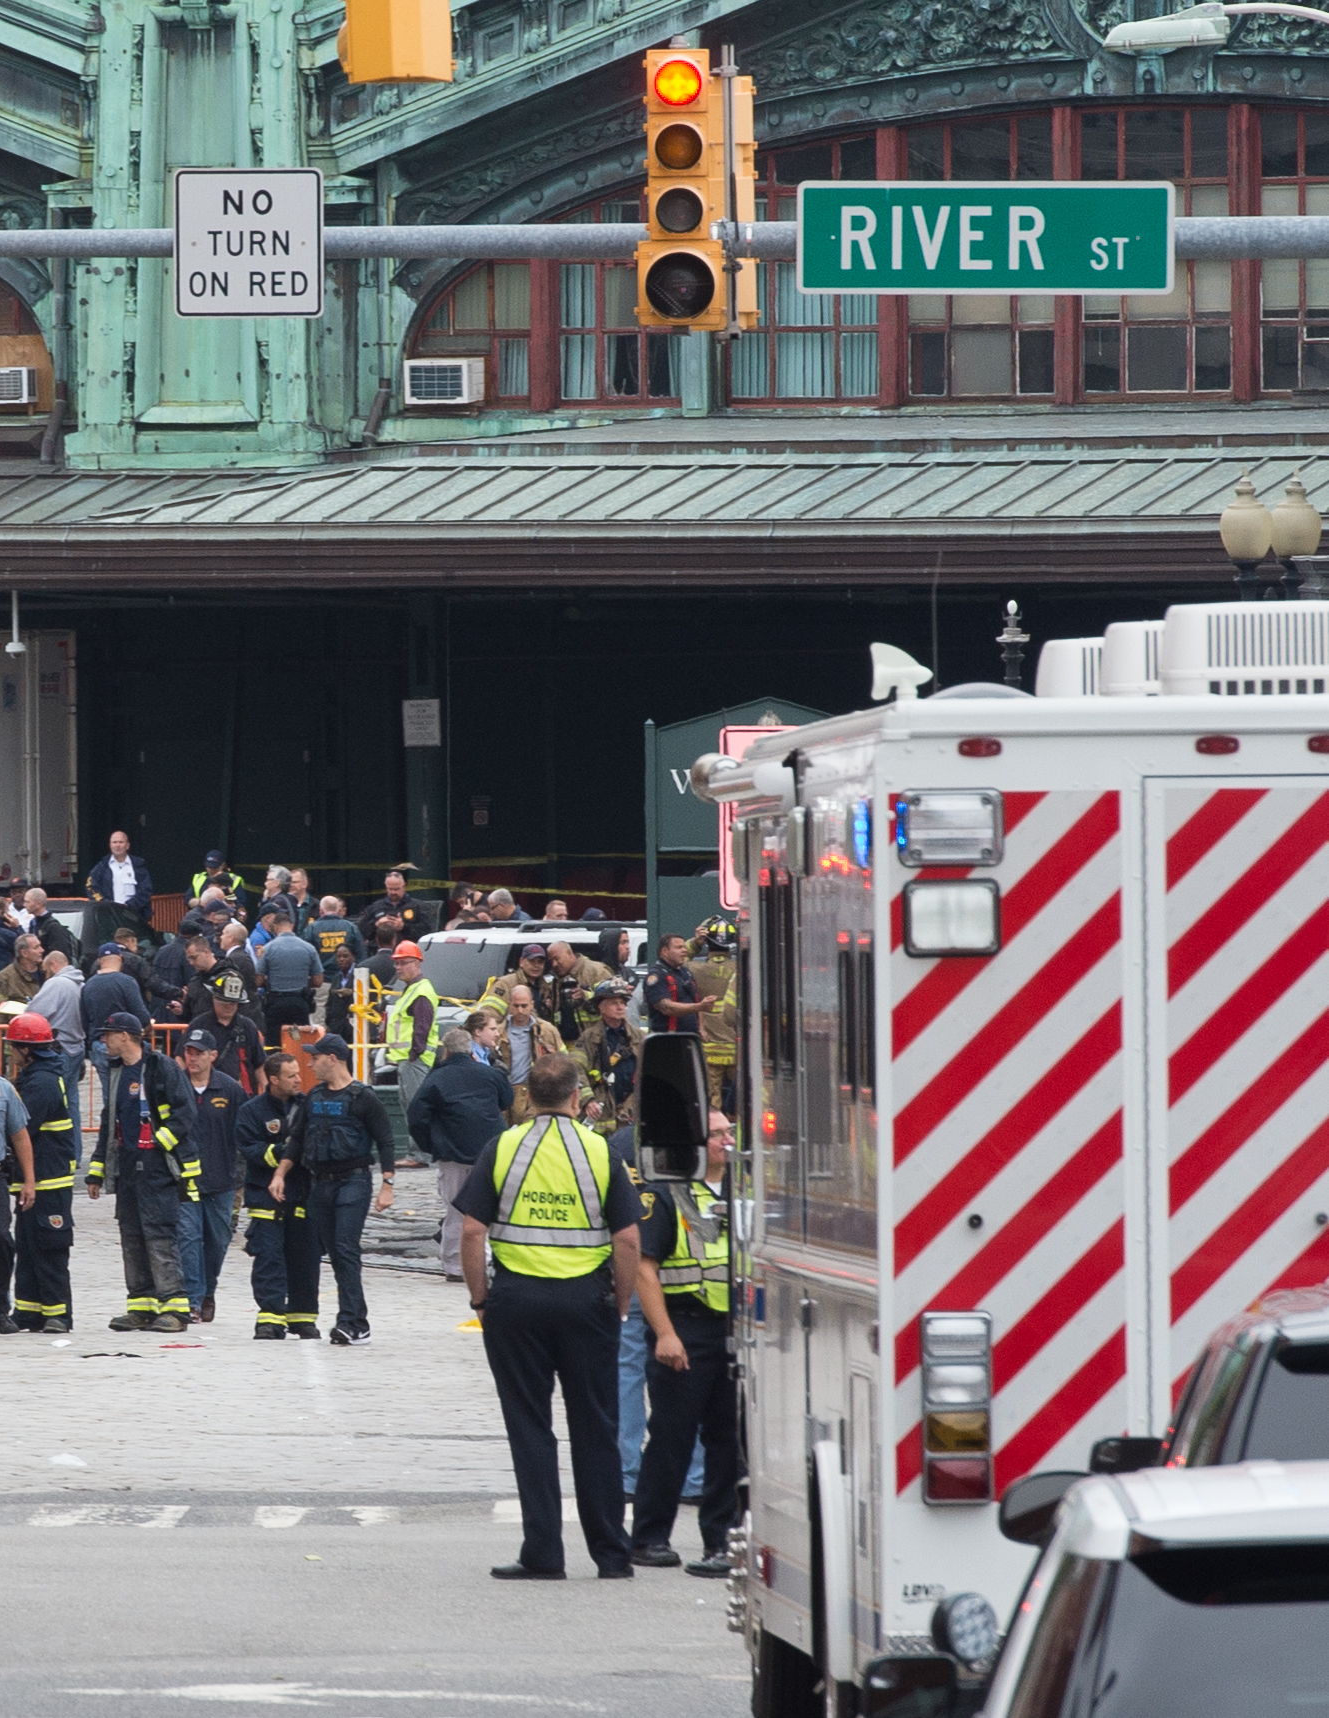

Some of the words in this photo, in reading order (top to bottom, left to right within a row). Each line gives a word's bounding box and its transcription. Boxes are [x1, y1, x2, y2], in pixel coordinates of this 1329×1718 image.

[222, 189, 273, 215] NO
[207, 230, 290, 257] TURN
[839, 205, 1047, 271] RIVER
[1089, 236, 1130, 271] ST
[189, 271, 228, 297] ON
[249, 271, 308, 297] RED
[522, 1191, 577, 1206] HOBOKEN
[529, 1207, 569, 1222] POLICE
